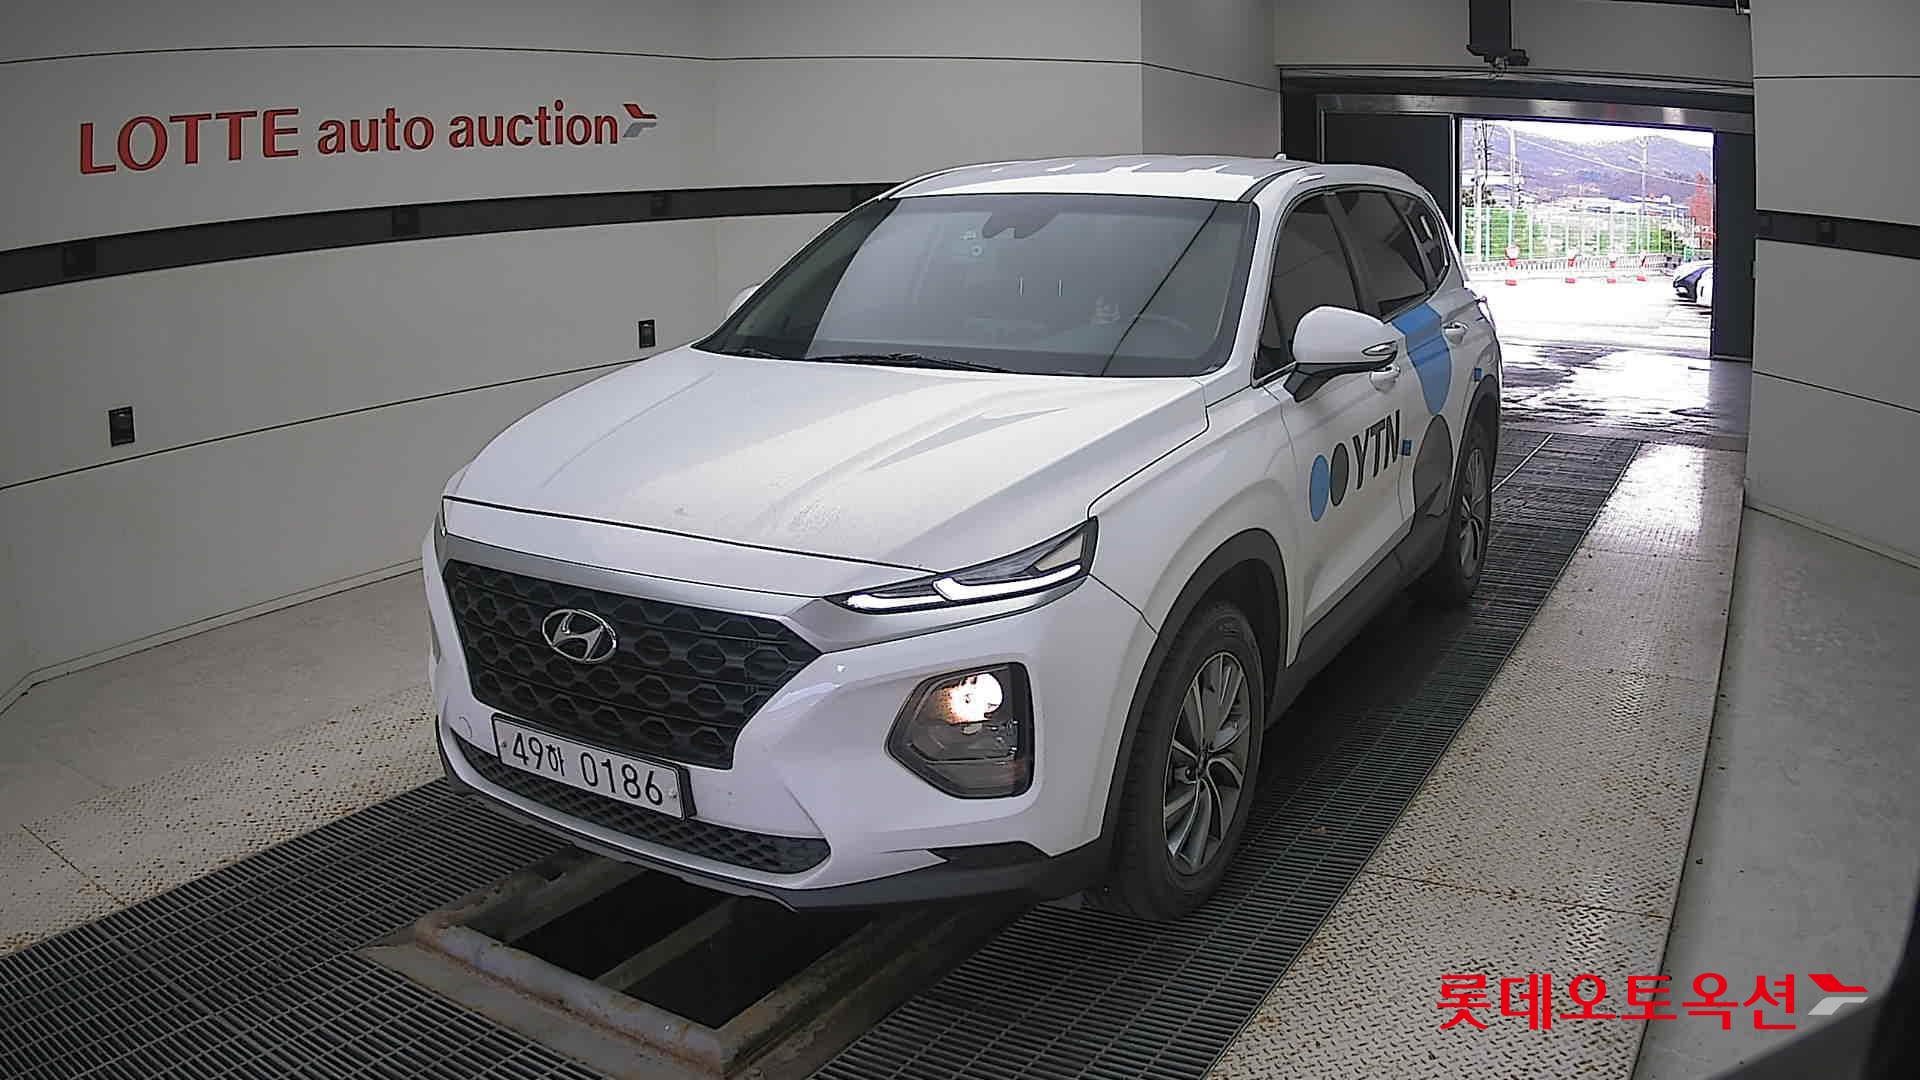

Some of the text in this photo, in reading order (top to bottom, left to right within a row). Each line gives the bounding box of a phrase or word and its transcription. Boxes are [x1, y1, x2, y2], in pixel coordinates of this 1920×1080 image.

[80, 99, 619, 175] LOTTE auto auction
[1352, 409, 1400, 490] YTN
[580, 751, 663, 806] 0186
